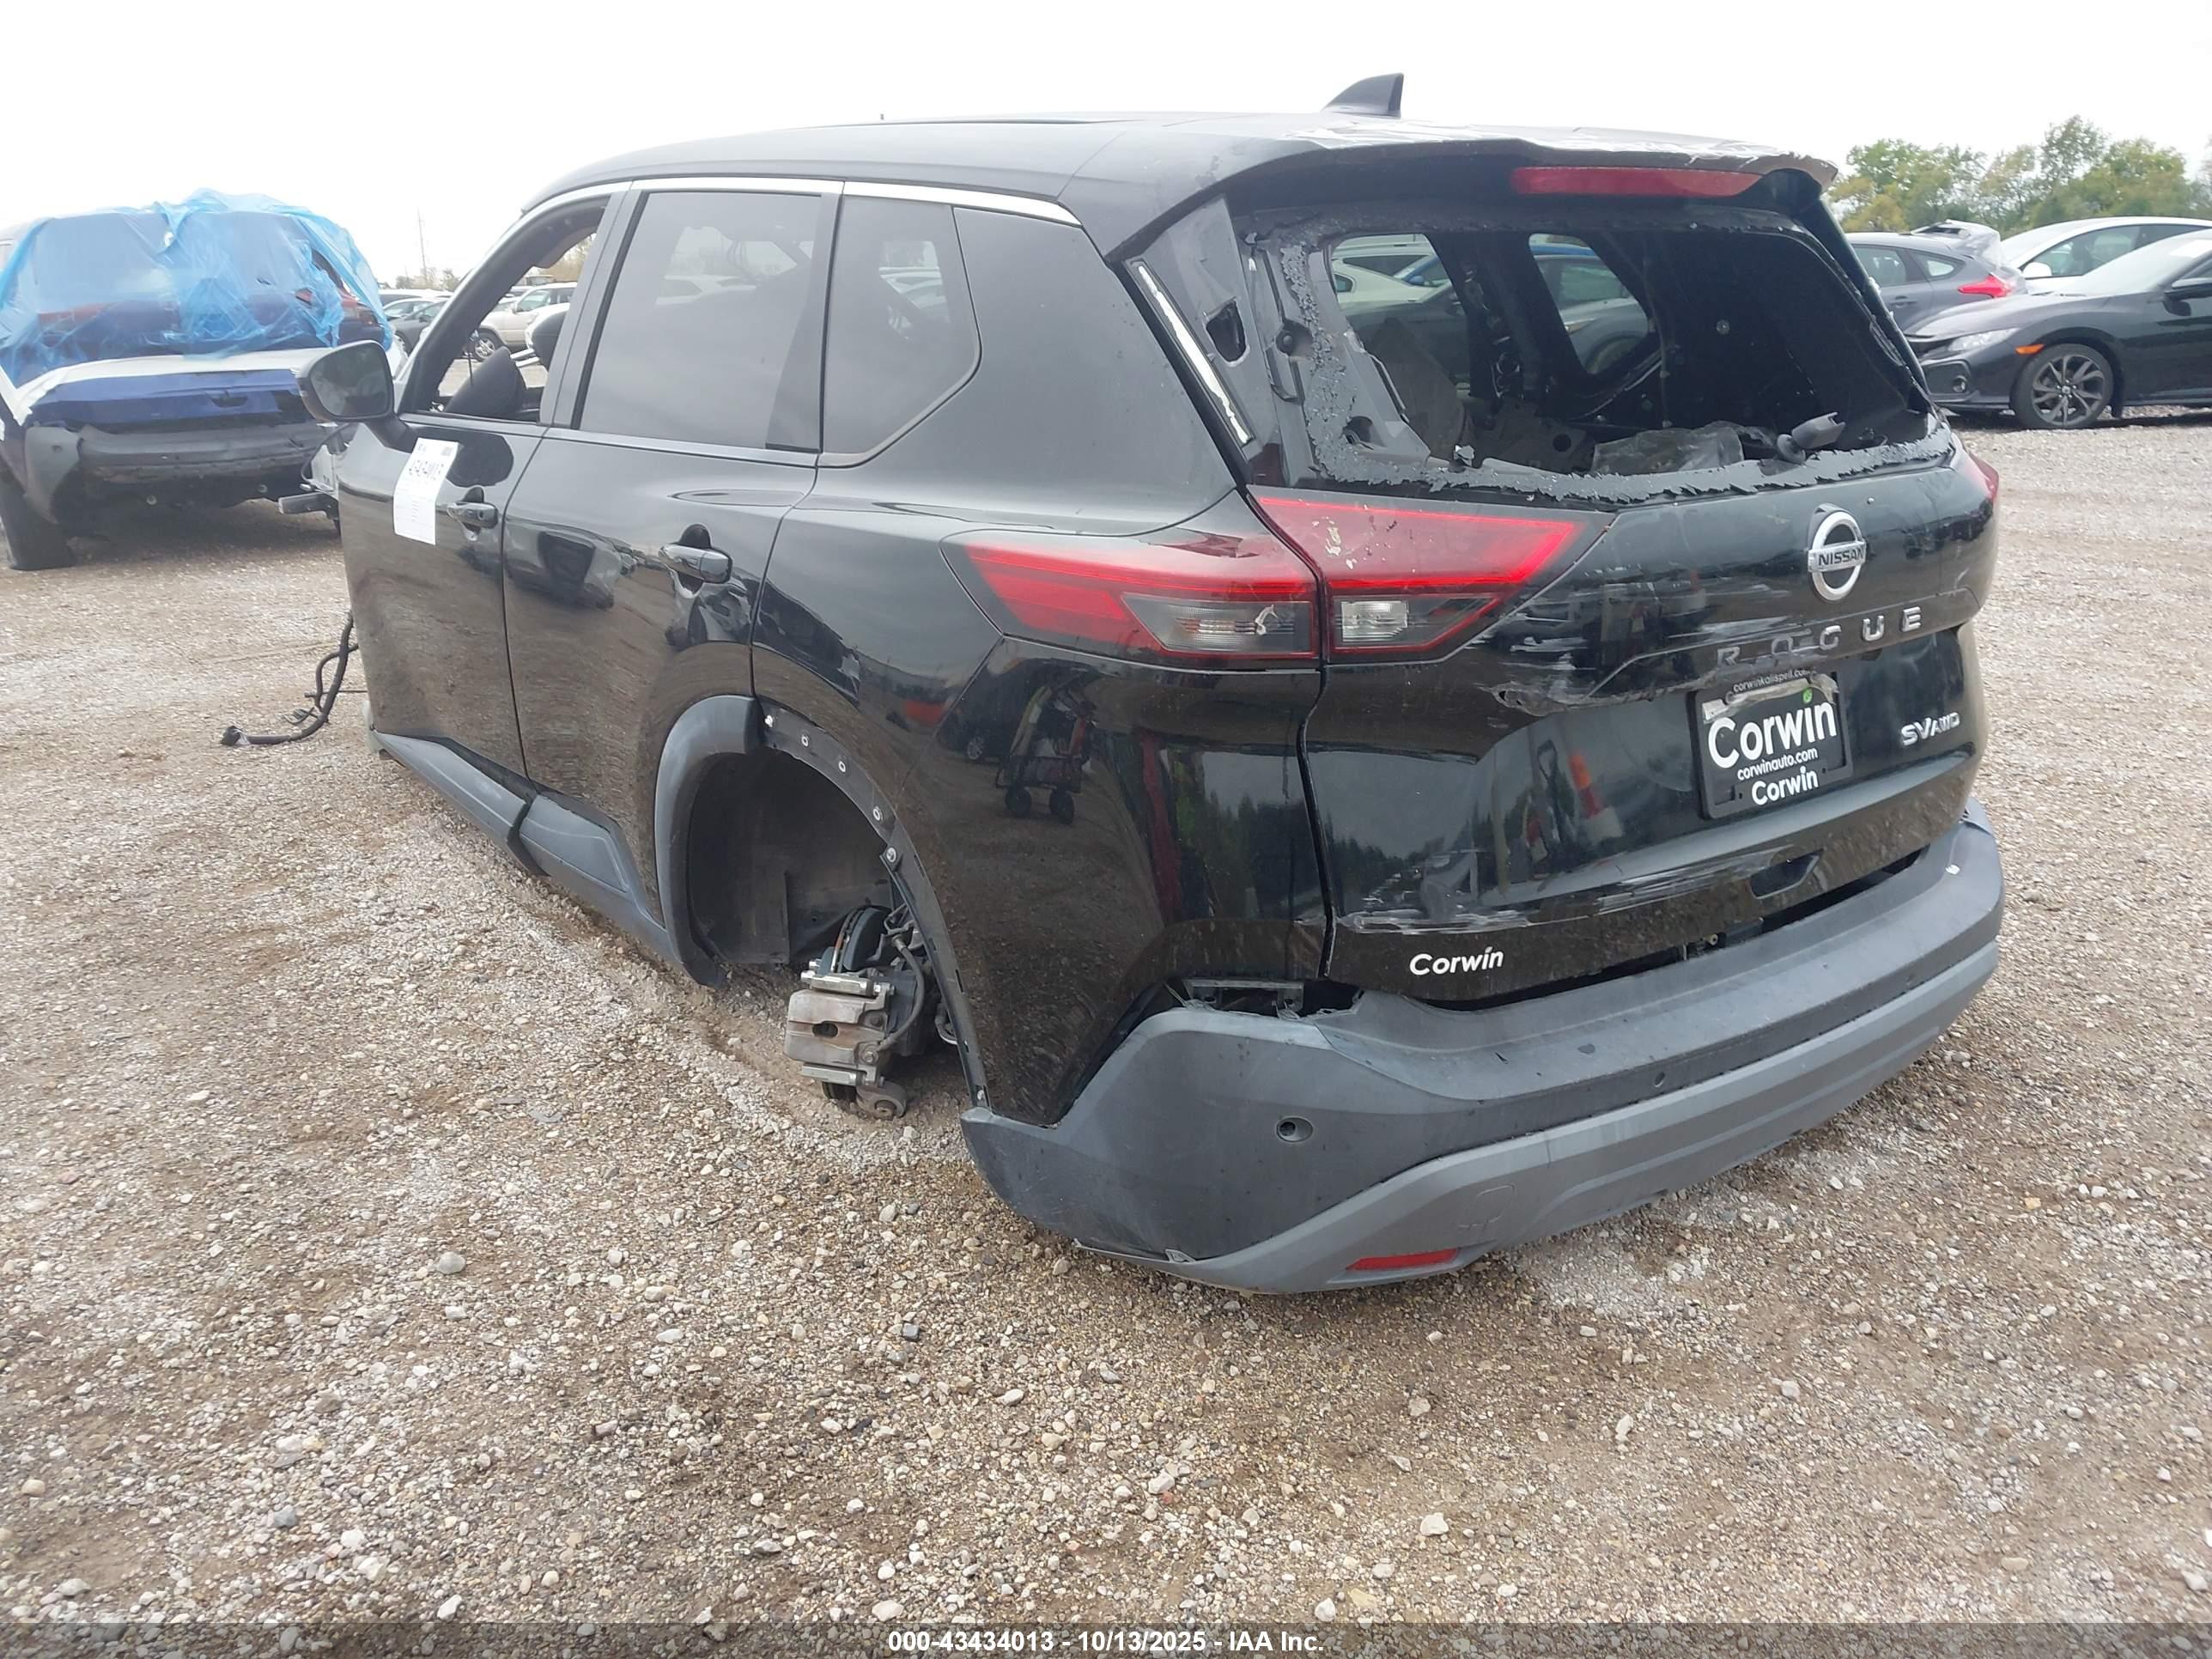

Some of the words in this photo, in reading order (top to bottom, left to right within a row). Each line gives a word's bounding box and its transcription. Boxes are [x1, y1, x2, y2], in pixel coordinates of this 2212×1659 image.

[1819, 548, 1864, 566] NISSAN
[1717, 606, 1921, 667] ROGUE
[1708, 690, 1838, 769] Corwin
[1737, 748, 1819, 781] corwinauto.com
[1751, 765, 1819, 805] Corwin
[1409, 946, 1504, 975] Corwin
